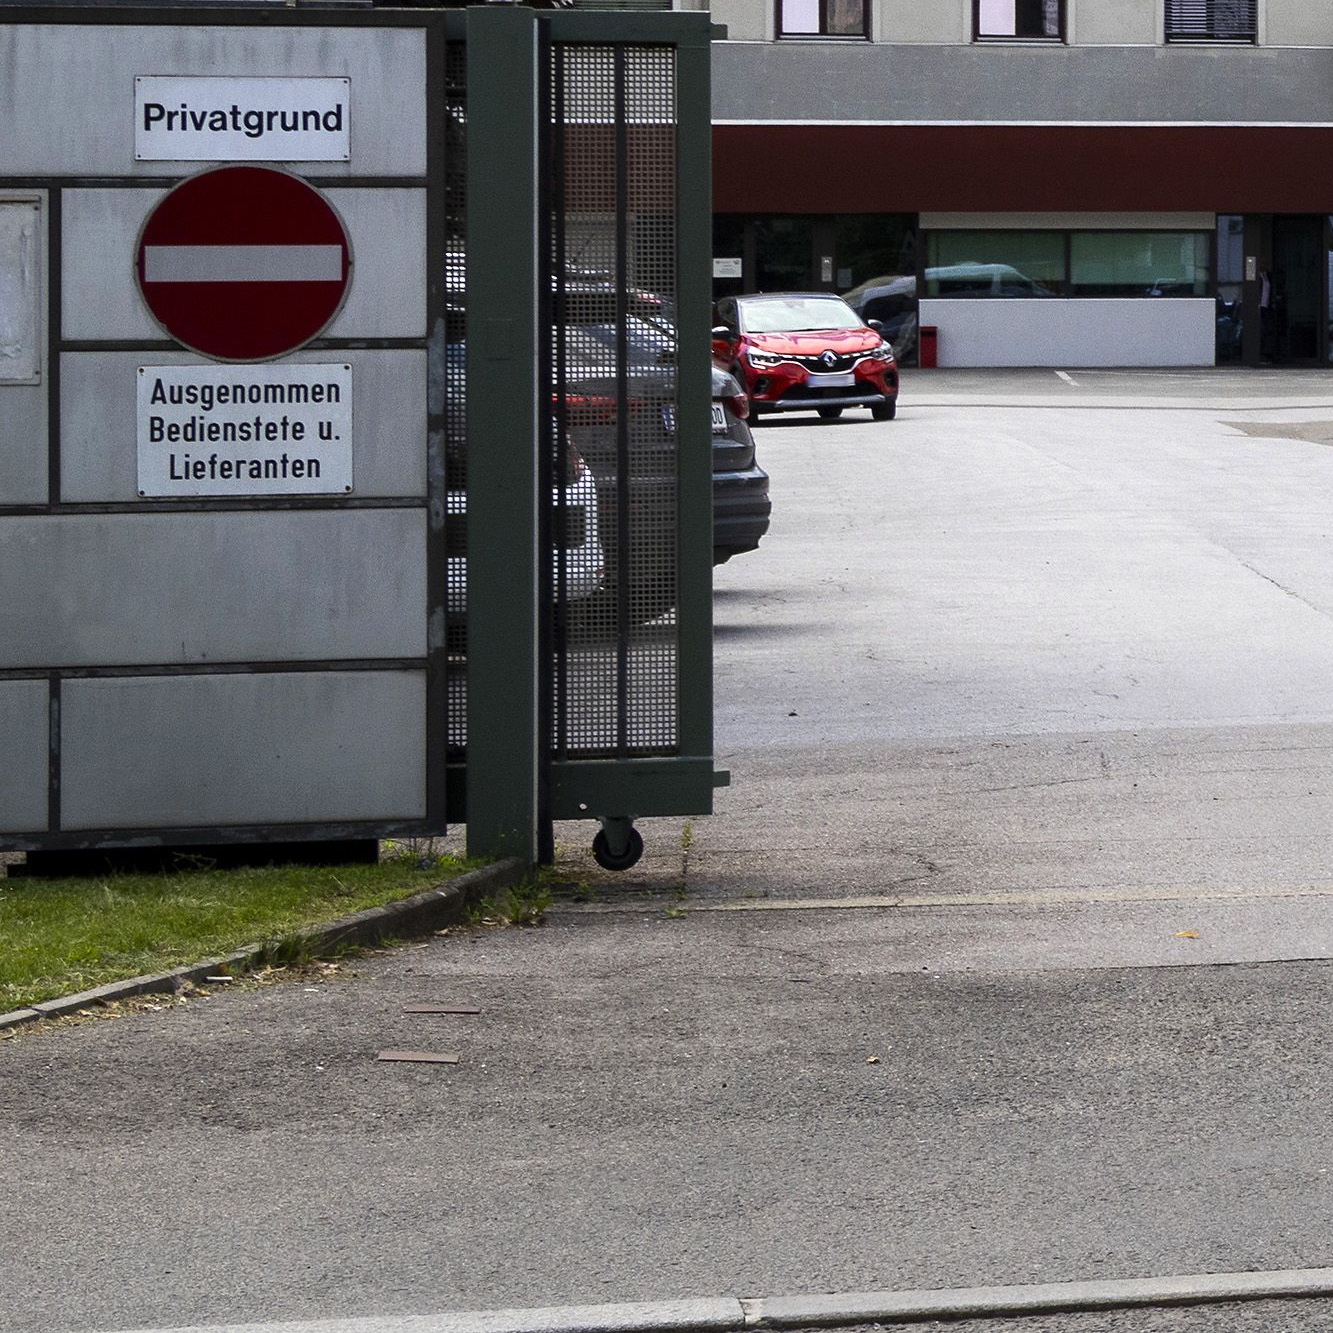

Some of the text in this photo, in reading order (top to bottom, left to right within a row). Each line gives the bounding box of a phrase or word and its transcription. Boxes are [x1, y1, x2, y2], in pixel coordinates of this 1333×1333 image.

[144, 103, 343, 139] Privatgrund
[151, 378, 340, 411] Ausgenommen
[150, 416, 340, 442] Bedienstete u.
[170, 453, 320, 480] Lieferanten
